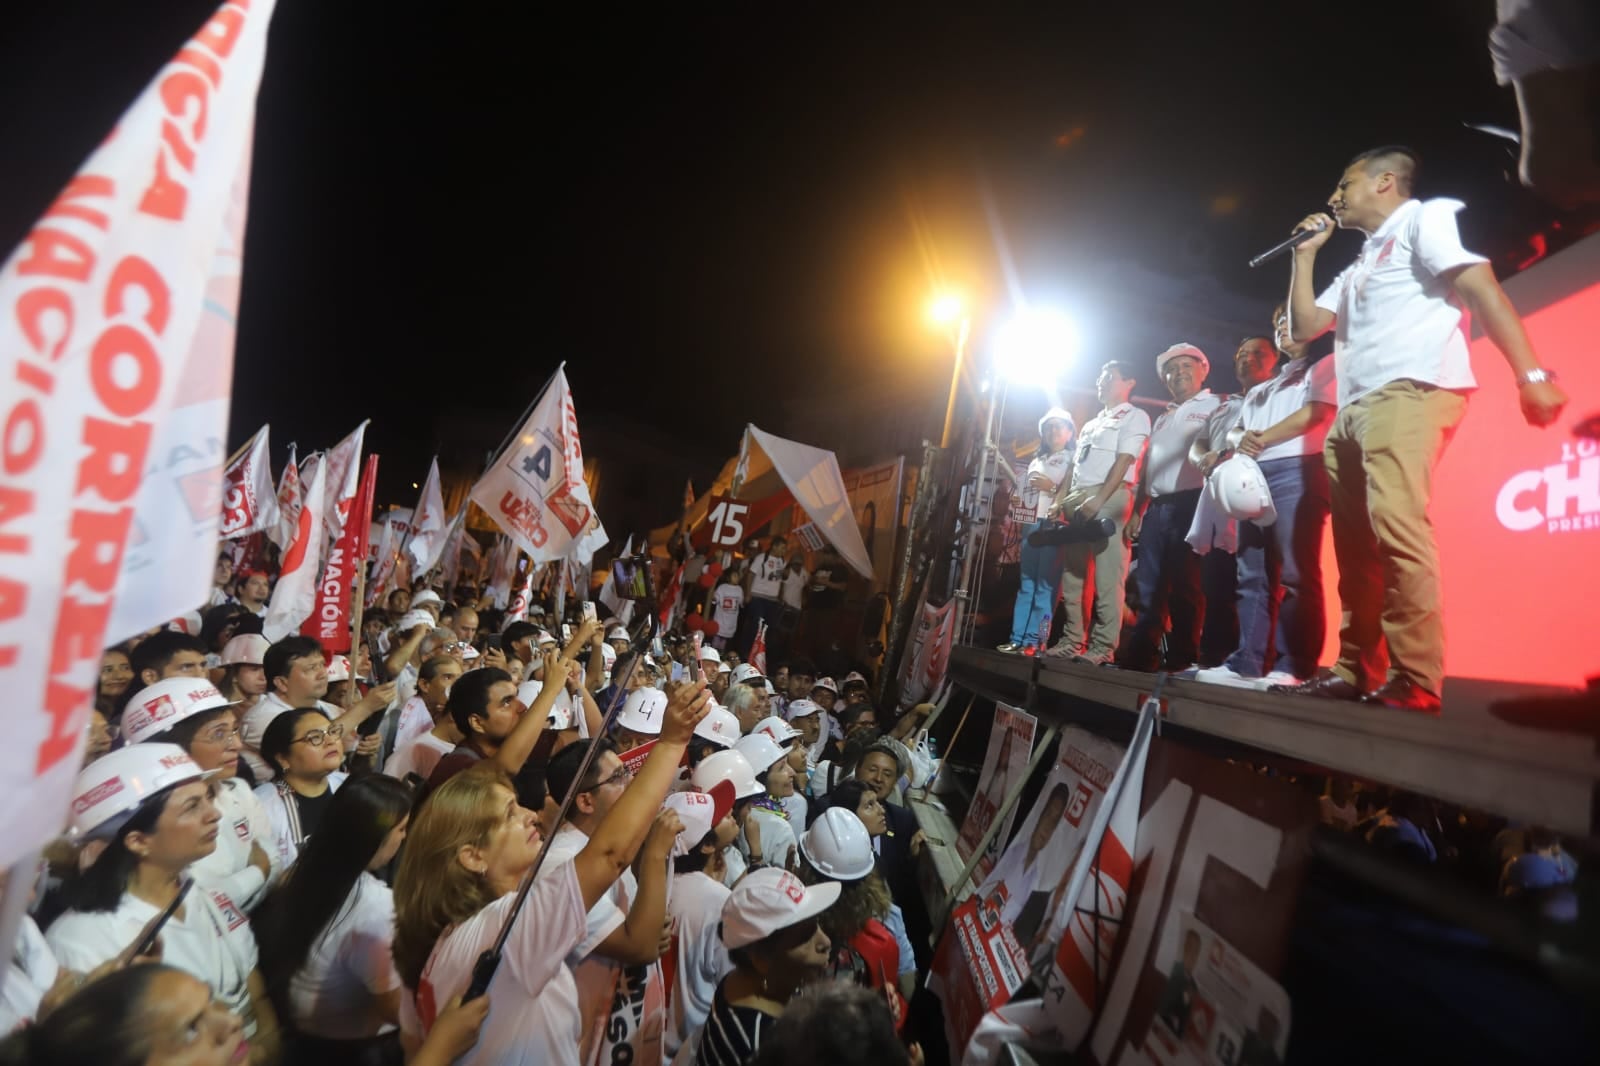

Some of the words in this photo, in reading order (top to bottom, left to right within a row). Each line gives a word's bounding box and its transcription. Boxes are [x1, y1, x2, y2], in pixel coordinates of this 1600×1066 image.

[35, 255, 171, 778] CORREA
[708, 502, 748, 545] 15
[320, 549, 343, 638] NACIÓN
[639, 700, 656, 721] 4
